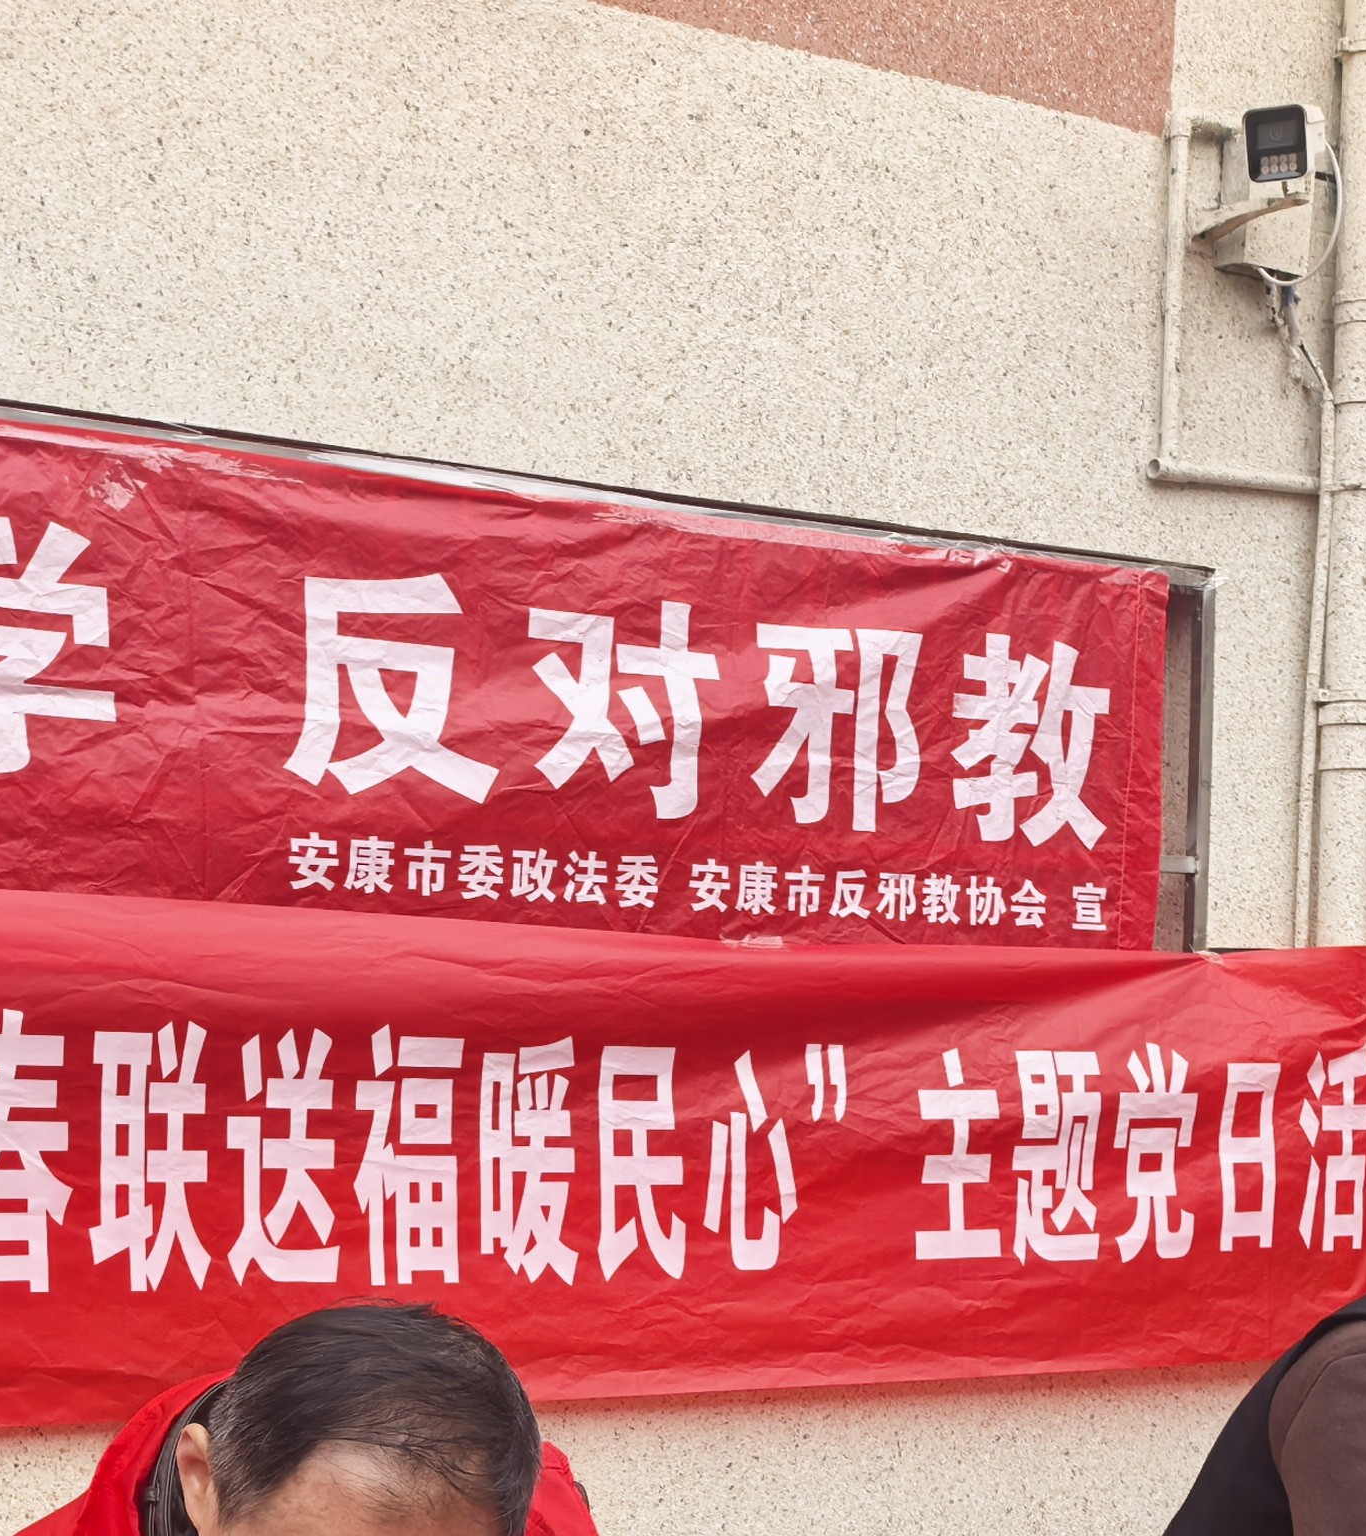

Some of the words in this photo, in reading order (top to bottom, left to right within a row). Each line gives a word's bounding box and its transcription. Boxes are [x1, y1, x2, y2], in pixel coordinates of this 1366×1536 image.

[283, 573, 1112, 850] 反对邪教
[289, 832, 659, 908] 安康市委政法委
[689, 858, 1047, 930] 安康市反邪教协会
[1072, 883, 1107, 931] 宣
